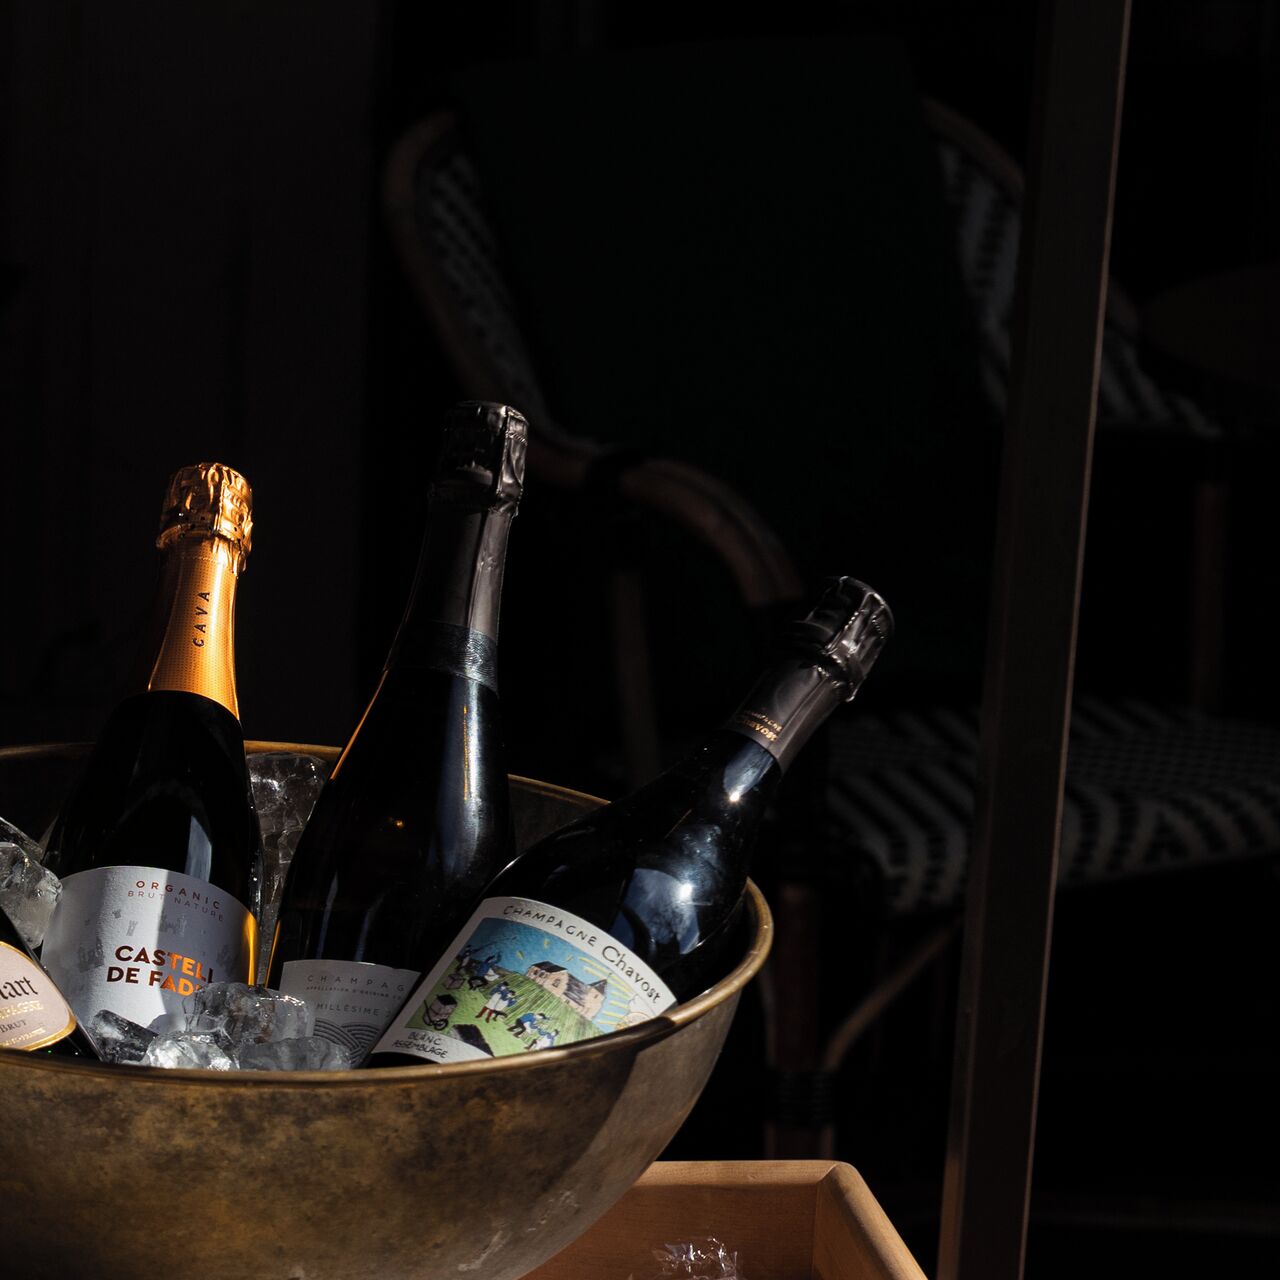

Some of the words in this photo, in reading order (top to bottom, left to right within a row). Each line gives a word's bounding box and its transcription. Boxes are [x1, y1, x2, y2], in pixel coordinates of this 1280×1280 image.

[193, 591, 210, 647] CAVA
[127, 890, 165, 900] BRUT
[174, 897, 224, 922] NATURE
[136, 880, 220, 909] ORGANIC
[503, 905, 597, 947] CHAMPAGNE
[602, 945, 661, 1003] Chavost
[107, 966, 140, 984] DE
[148, 970, 203, 997] FAD
[408, 1031, 441, 1046] BLANC
